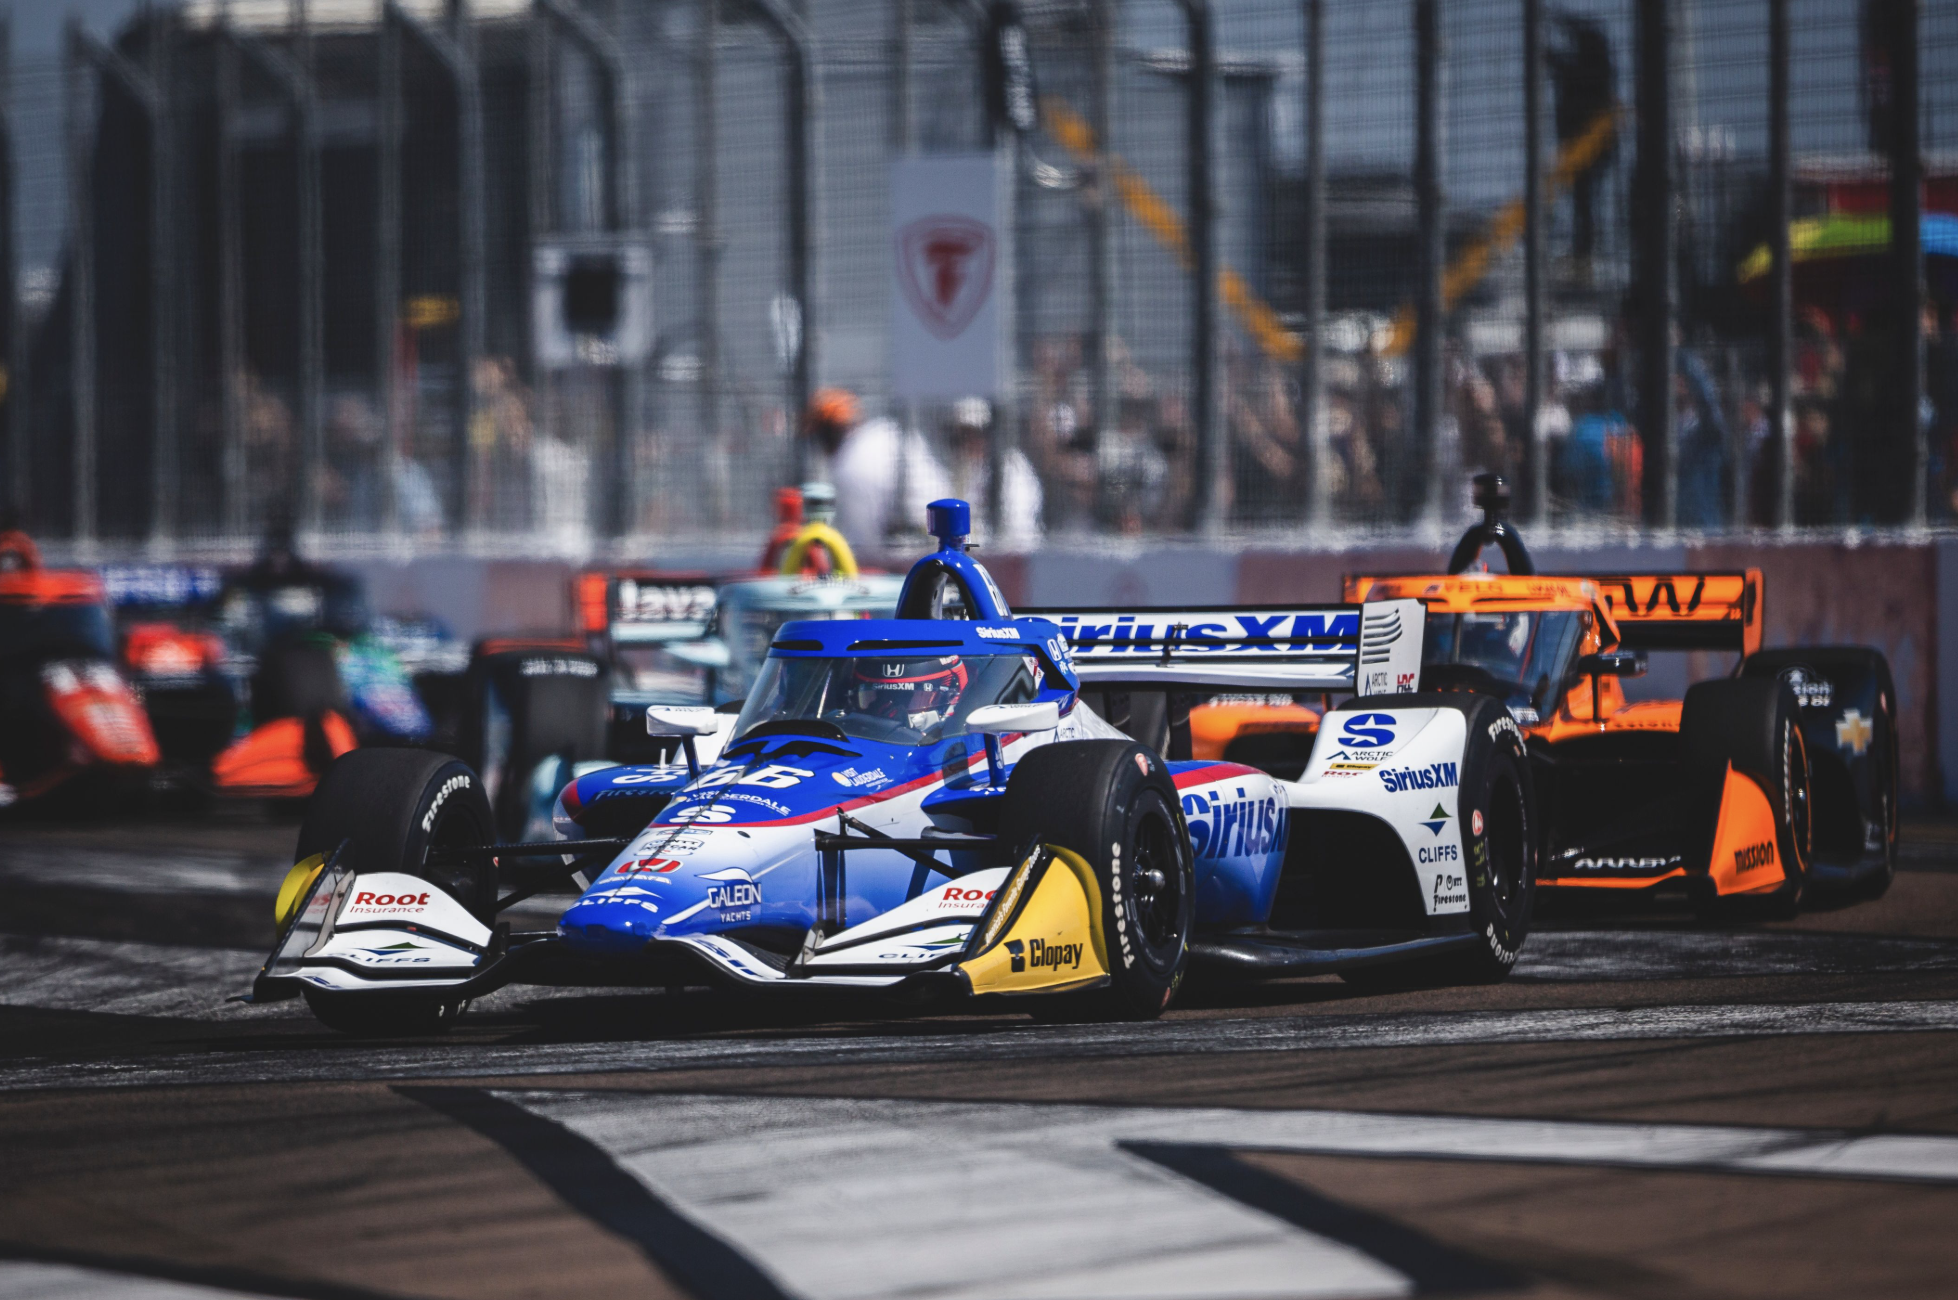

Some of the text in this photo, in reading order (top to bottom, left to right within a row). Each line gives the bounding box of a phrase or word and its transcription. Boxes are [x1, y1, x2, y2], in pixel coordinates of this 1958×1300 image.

[975, 626, 1020, 640] SiriusXM
[1014, 615, 1360, 652] iriusXM
[872, 681, 915, 691] SiriusXM
[1378, 761, 1459, 794] SiriusXM
[420, 774, 471, 833] Firestone
[1419, 845, 1458, 864] CLIFFS
[1733, 840, 1775, 875] mission
[354, 891, 431, 906] Root
[706, 882, 762, 909] GALEON
[1111, 842, 1135, 970] Firestone
[1433, 894, 1467, 907] Firestone
[349, 905, 425, 914] Insurance
[720, 911, 752, 924] YACHTS
[1029, 938, 1084, 972] Clopay
